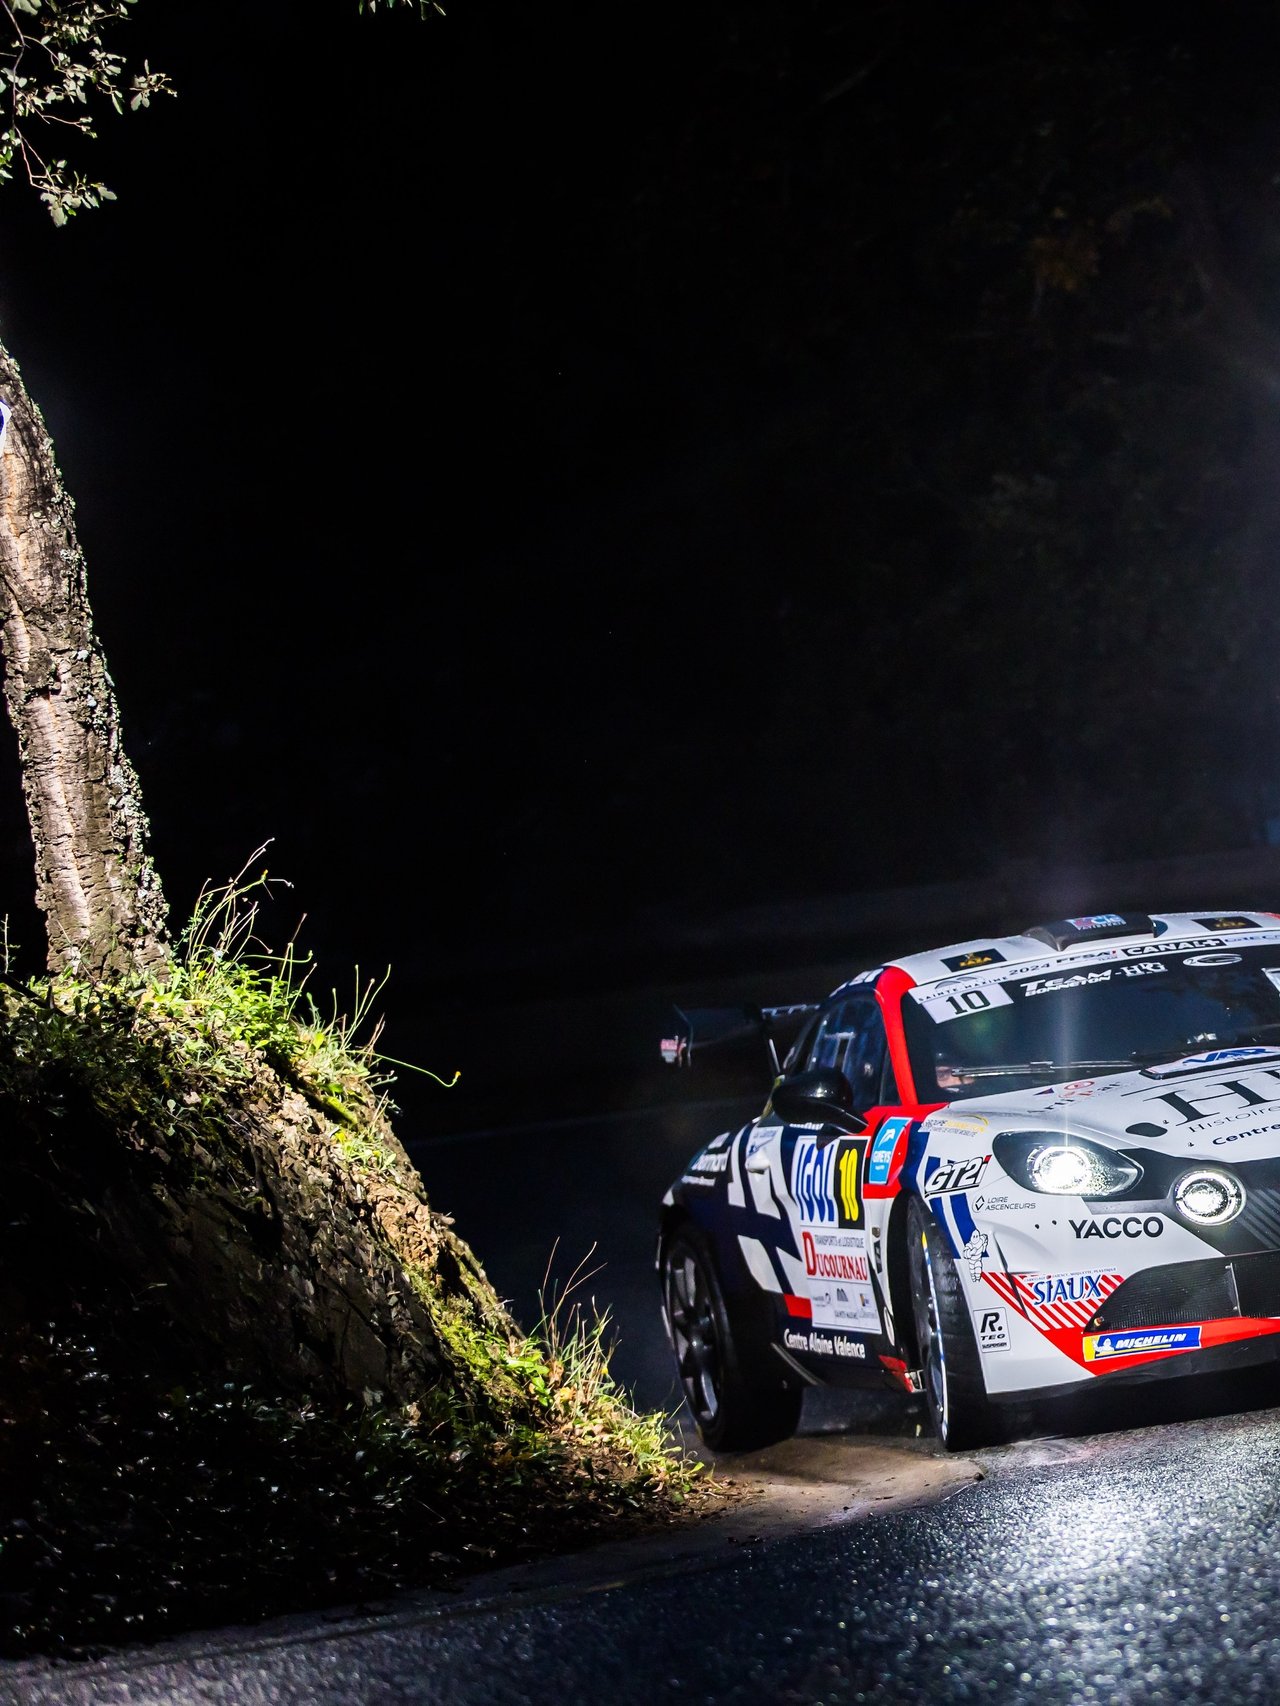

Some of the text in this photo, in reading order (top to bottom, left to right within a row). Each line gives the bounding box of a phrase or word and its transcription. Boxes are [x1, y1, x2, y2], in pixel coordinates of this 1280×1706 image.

[1127, 939, 1220, 955] CANAL+
[1009, 963, 1051, 976] 2024
[946, 989, 991, 1015] 10
[925, 1154, 993, 1193] GT2i
[839, 1148, 859, 1222] 10
[985, 1201, 1036, 1211] ASCENCEURS
[987, 1196, 1009, 1204] LOIRE
[1068, 1216, 1164, 1239] YACCO
[784, 1328, 866, 1359] Centre Alpine Valence
[1115, 1333, 1187, 1349] MICHELIN
